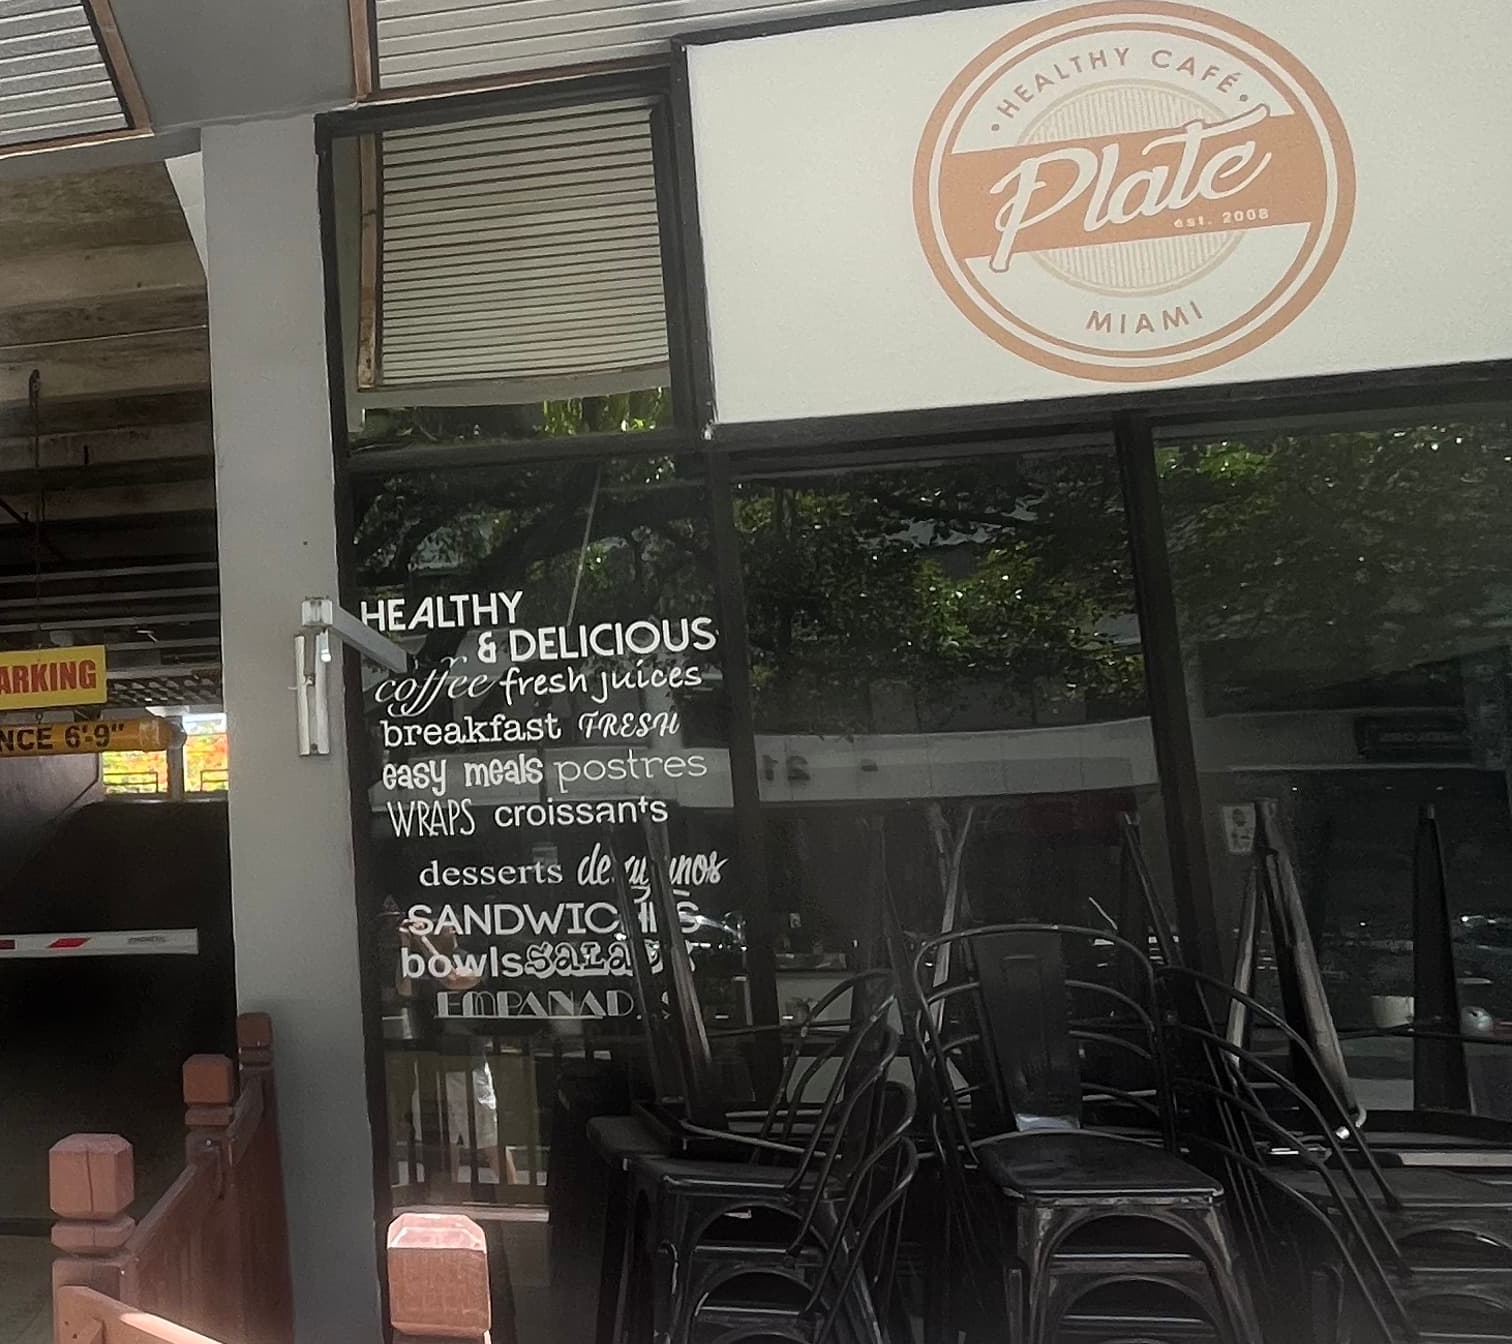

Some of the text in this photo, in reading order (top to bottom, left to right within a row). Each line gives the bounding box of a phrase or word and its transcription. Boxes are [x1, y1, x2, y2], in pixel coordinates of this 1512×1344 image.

[997, 47, 1243, 120] HEALTHY CAFÉ
[989, 103, 1272, 273] Plate
[1086, 300, 1203, 334] MIAMI
[360, 591, 524, 632] HEALTHY
[477, 617, 717, 664] & DELICIOUS
[374, 657, 702, 718] coffee fresh juices
[380, 713, 562, 747] breakfast
[382, 749, 708, 796] easy meals postres
[387, 796, 669, 838] WRAPS croissants
[419, 859, 563, 886] desserts
[401, 943, 523, 978] bowls
[435, 990, 671, 1019] EMPANAD
